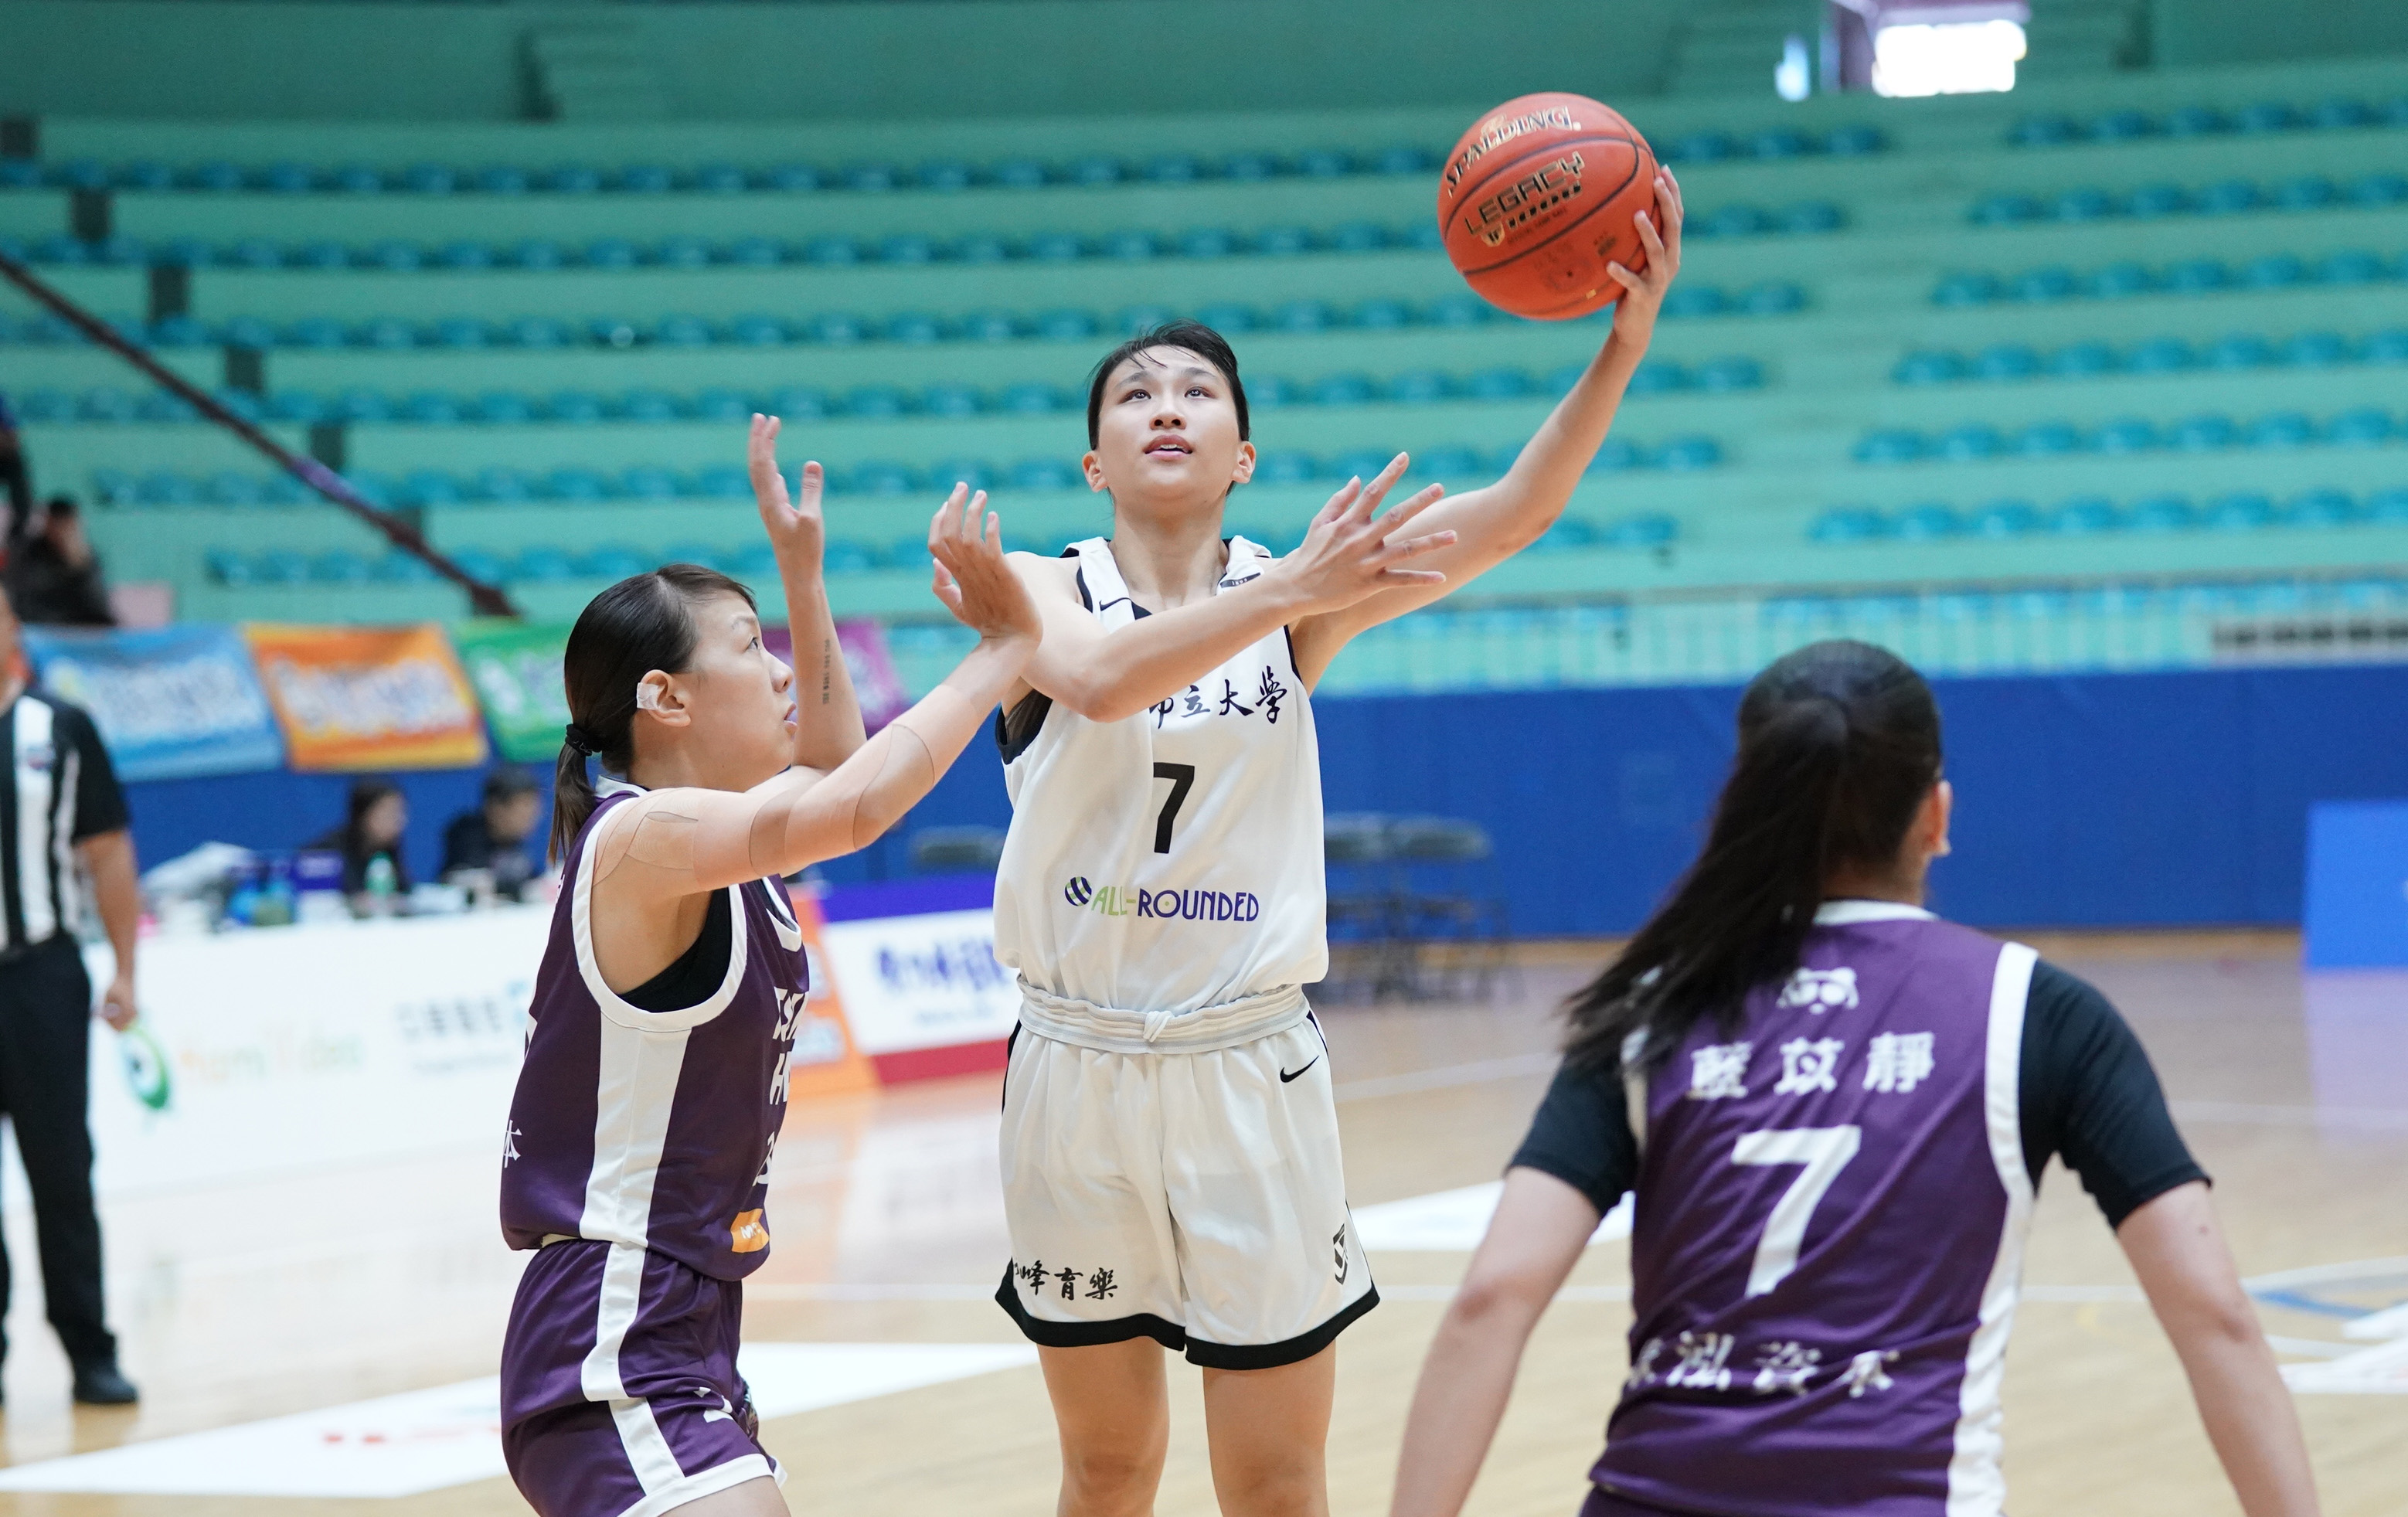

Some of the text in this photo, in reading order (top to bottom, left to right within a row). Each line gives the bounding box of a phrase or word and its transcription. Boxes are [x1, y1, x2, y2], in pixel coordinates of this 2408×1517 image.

[1464, 151, 1585, 236] LEGACY
[1152, 761, 1195, 854] 7
[1090, 886, 1260, 923] ALL-ROUNDED
[1731, 1124, 1862, 1298] 7
[1013, 1260, 1118, 1301] 峰育樂
